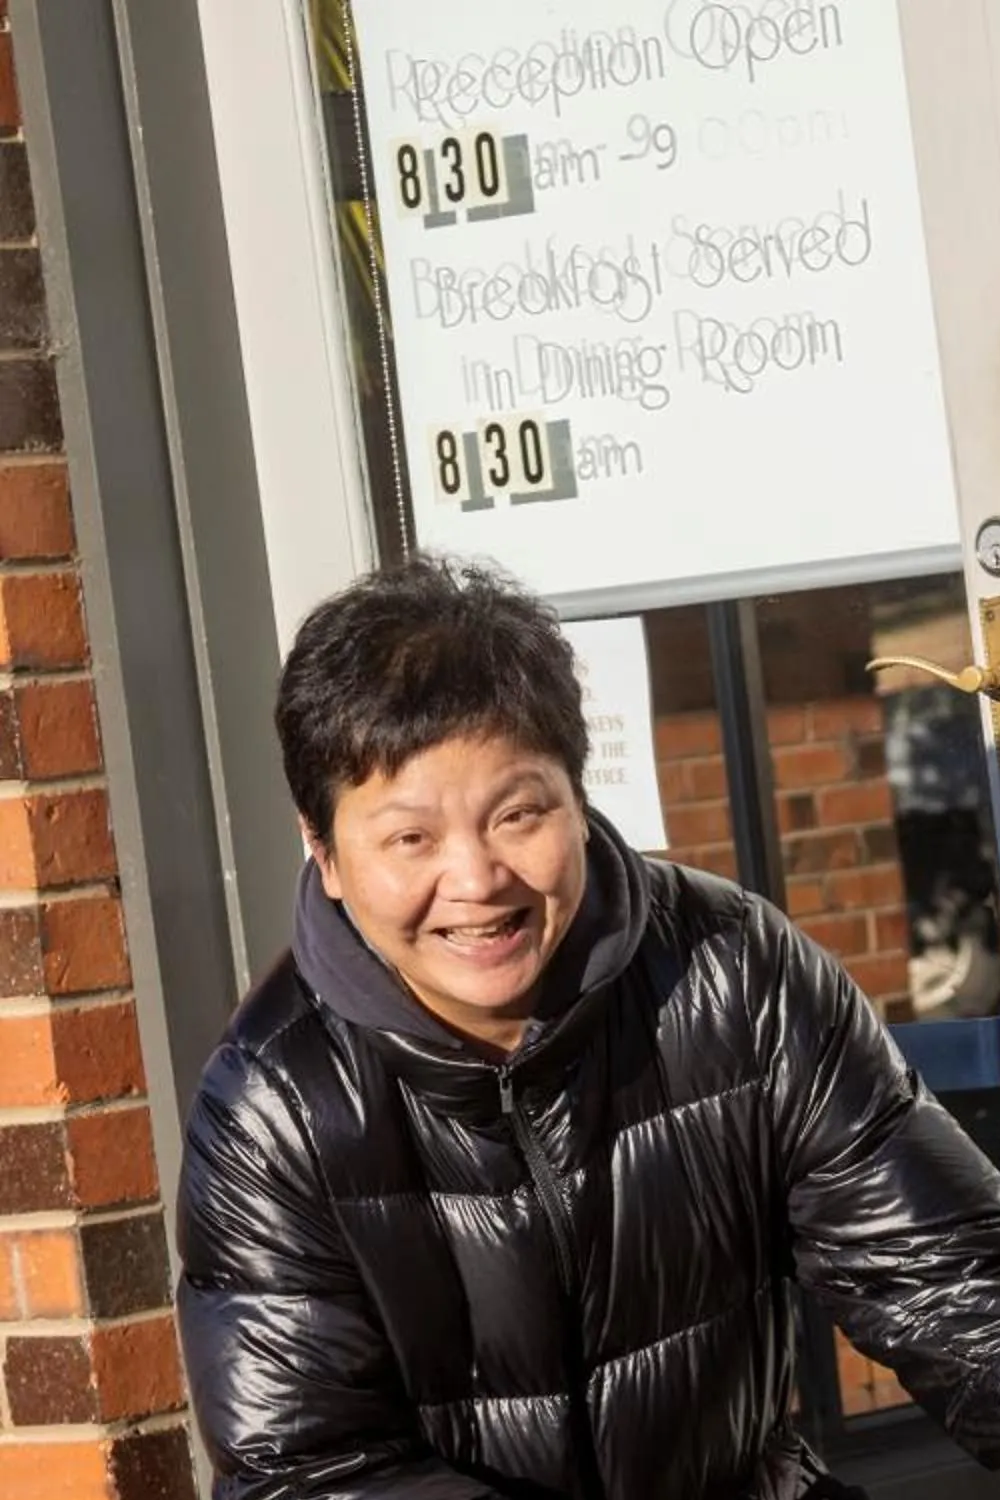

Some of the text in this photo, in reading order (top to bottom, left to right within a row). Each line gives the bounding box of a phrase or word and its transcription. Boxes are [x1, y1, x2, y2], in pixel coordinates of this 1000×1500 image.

[404, 2, 843, 128] Reception Open
[430, 196, 872, 328] Breakfast Served
[532, 340, 671, 411] Dining
[691, 315, 843, 393] Room
